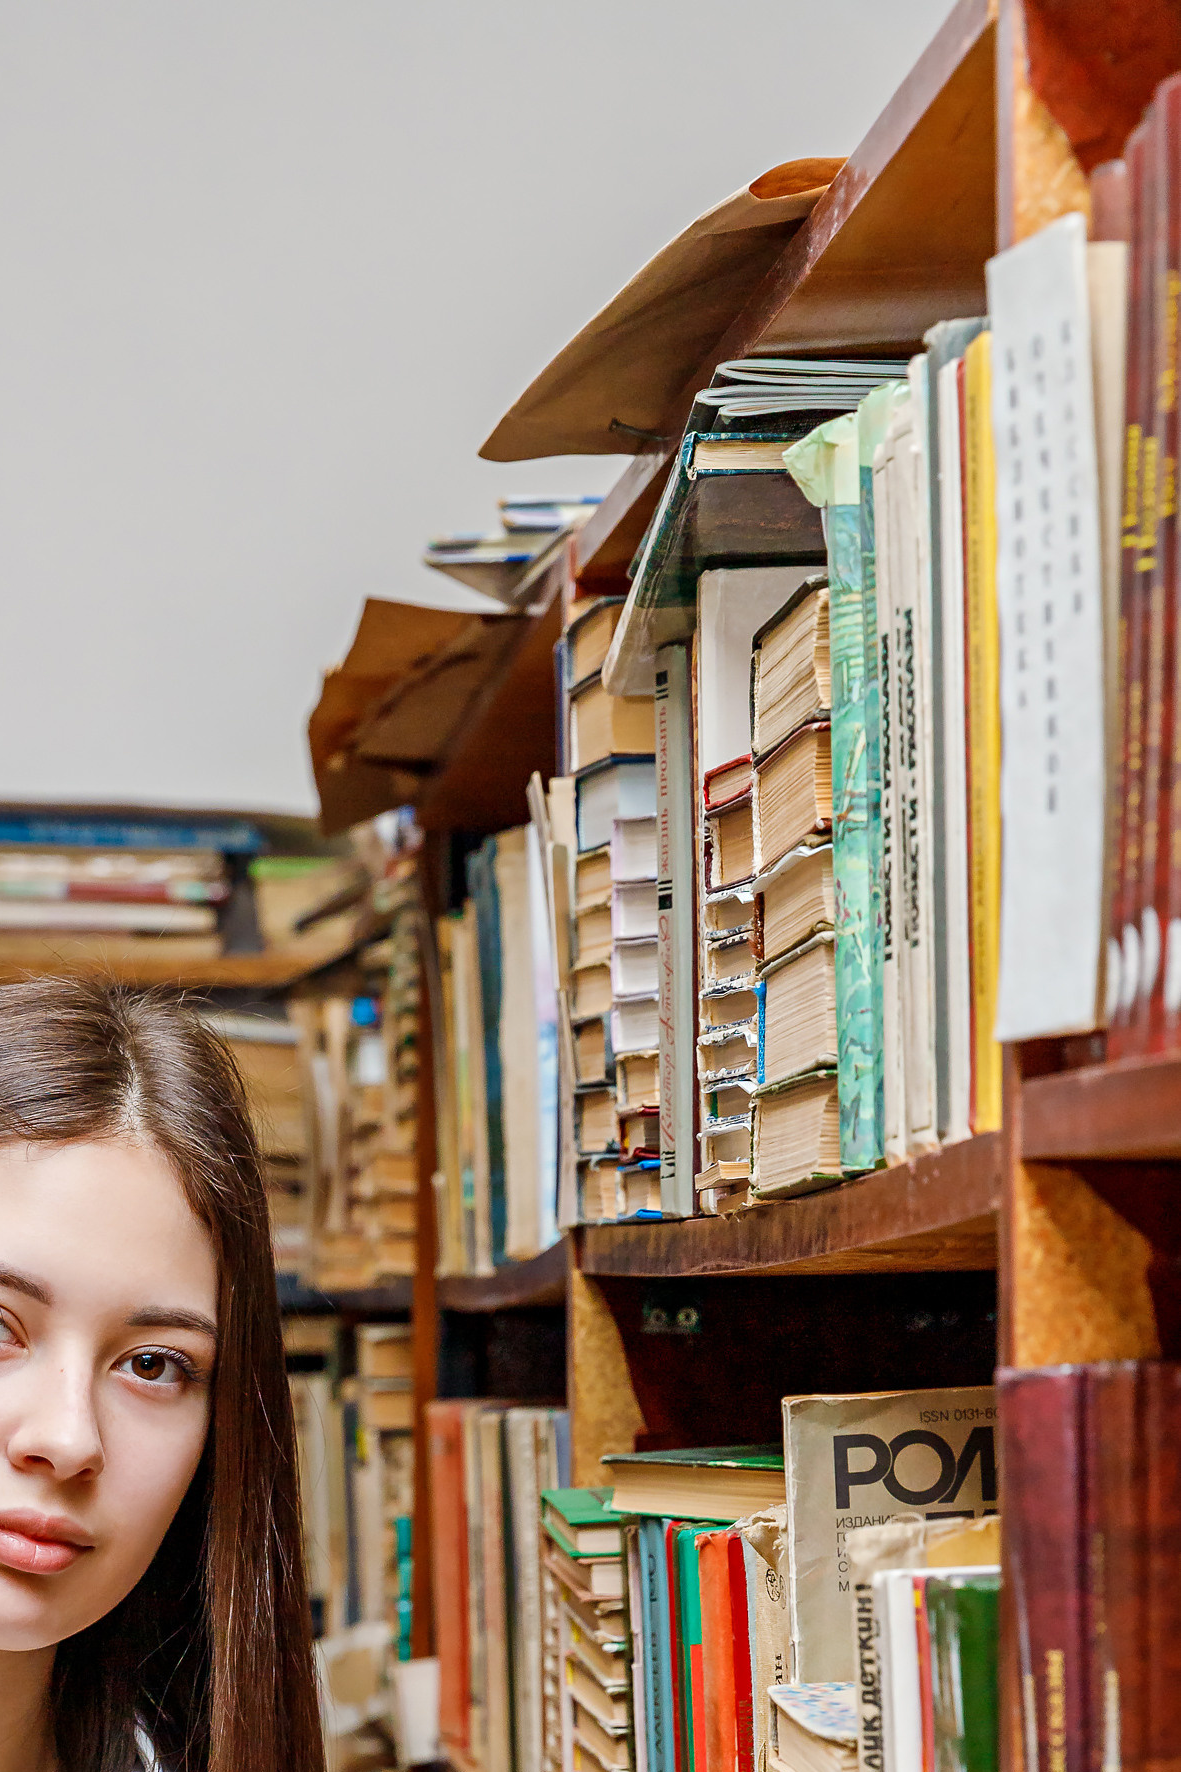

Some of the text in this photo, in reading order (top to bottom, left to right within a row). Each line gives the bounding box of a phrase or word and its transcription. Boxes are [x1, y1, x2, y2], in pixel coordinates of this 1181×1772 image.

[659, 705, 669, 875] ЖИЗНЬ ПРОЖИТЬ
[919, 1409, 950, 1424] ISSN
